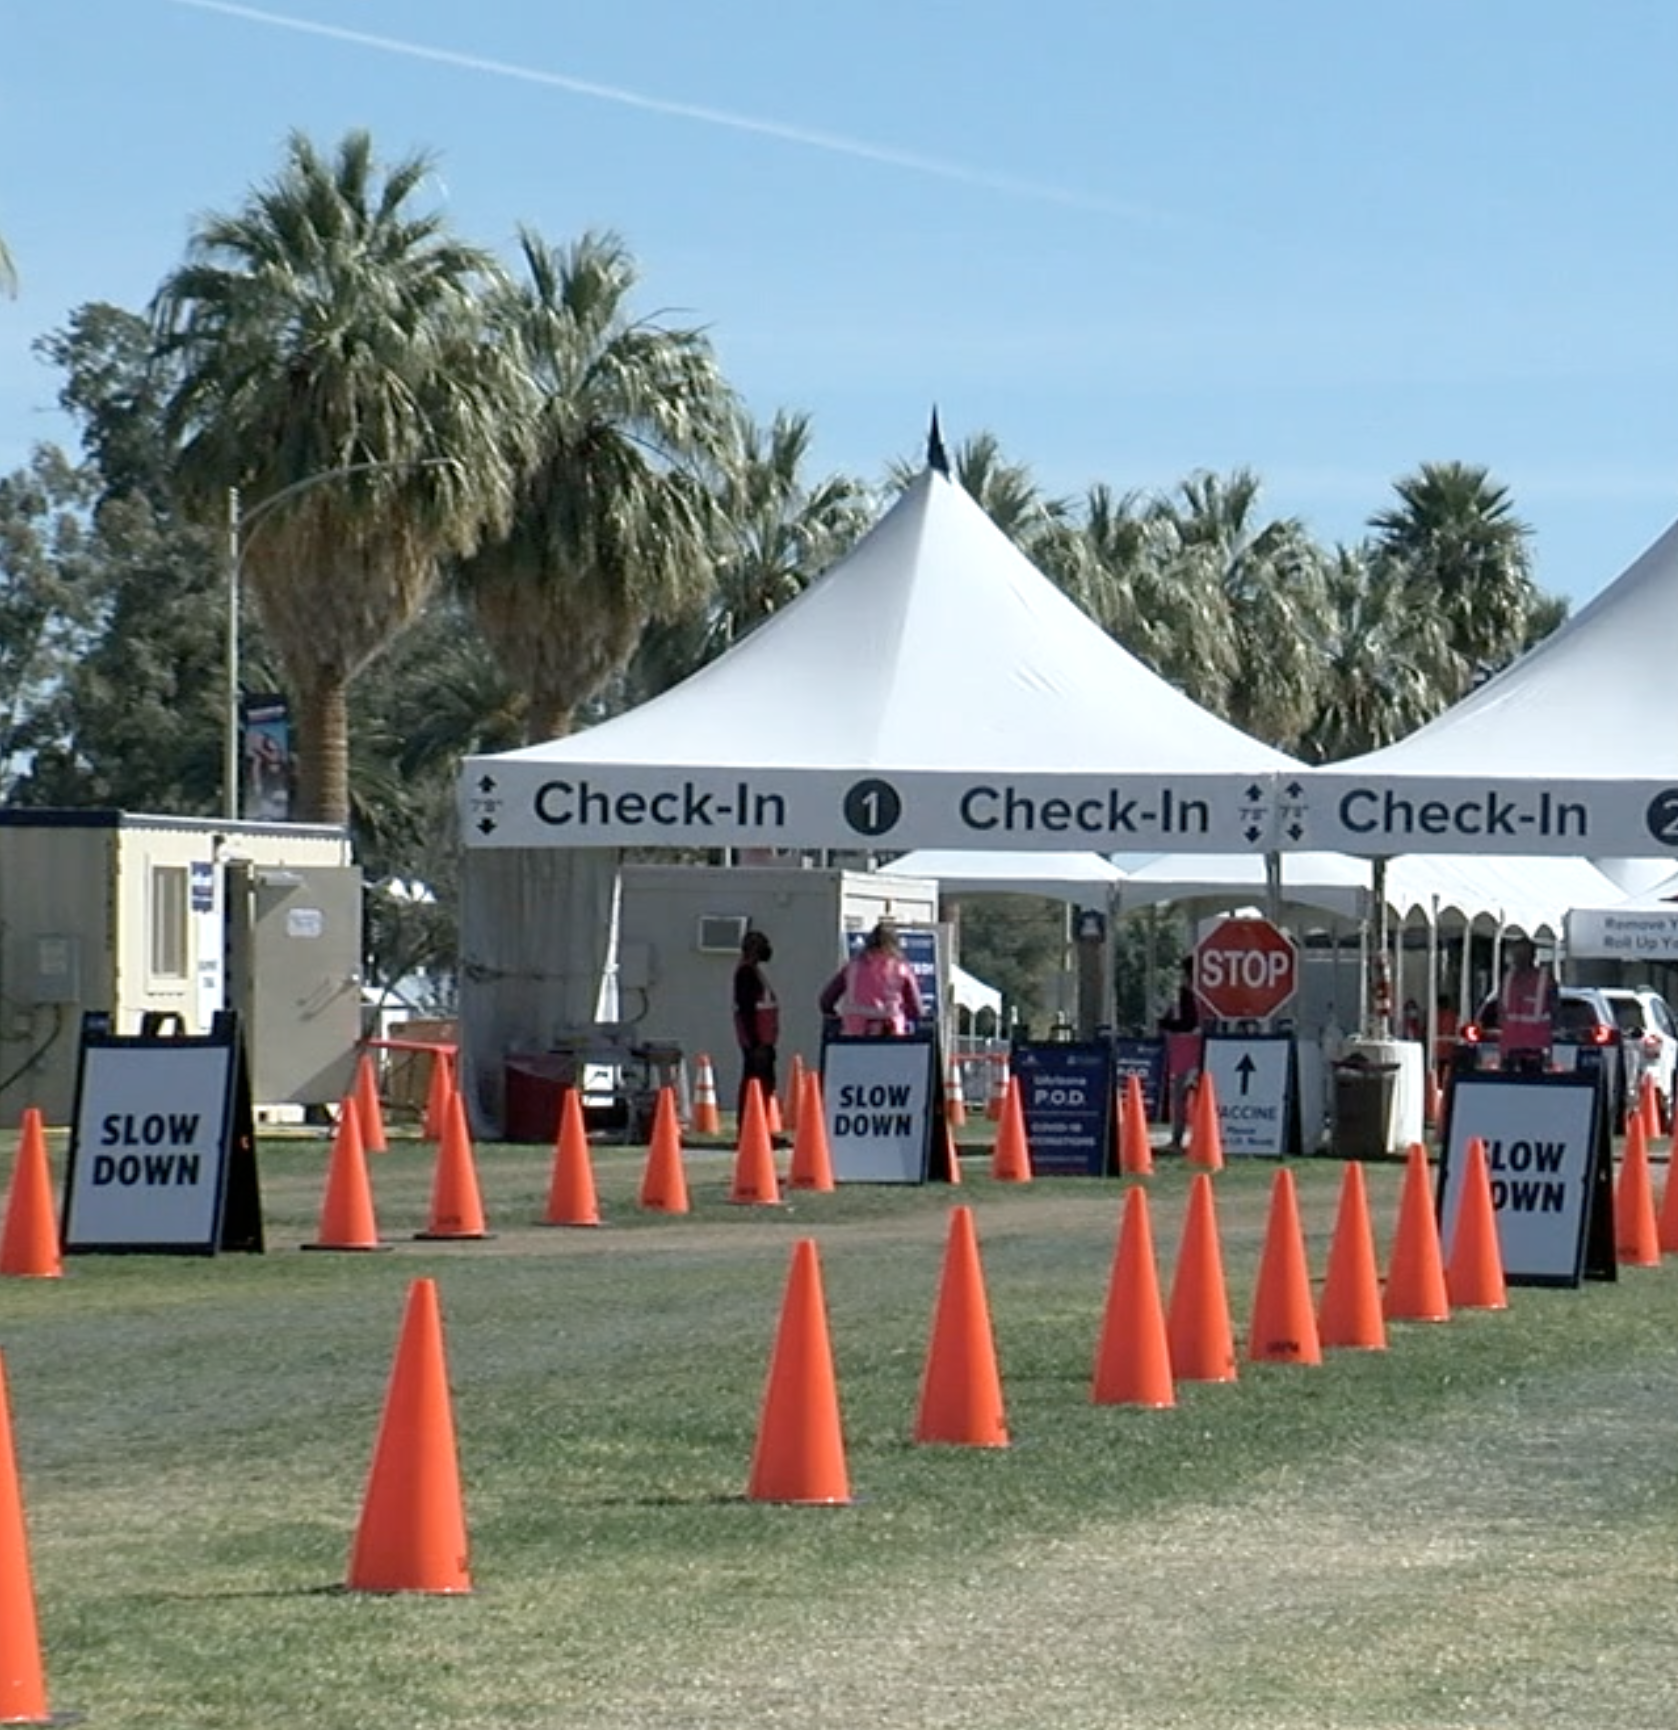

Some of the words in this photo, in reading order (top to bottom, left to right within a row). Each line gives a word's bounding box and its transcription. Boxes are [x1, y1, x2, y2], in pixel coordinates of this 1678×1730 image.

[533, 780, 785, 826] Check-In
[960, 785, 1209, 833] Check-In
[1339, 788, 1587, 836] Check-In
[1604, 917, 1666, 931] Remove
[1604, 935, 1631, 949] Roll
[1636, 936, 1657, 951] Up
[1202, 948, 1289, 988] STOP
[839, 1084, 911, 1108] SLOW
[834, 1113, 912, 1137] DOWN
[1217, 1105, 1279, 1120] ACCINE
[101, 1113, 200, 1146] SLOW
[93, 1155, 200, 1186] DOWN
[1484, 1140, 1566, 1173] LOW
[1490, 1181, 1566, 1213] OWN
